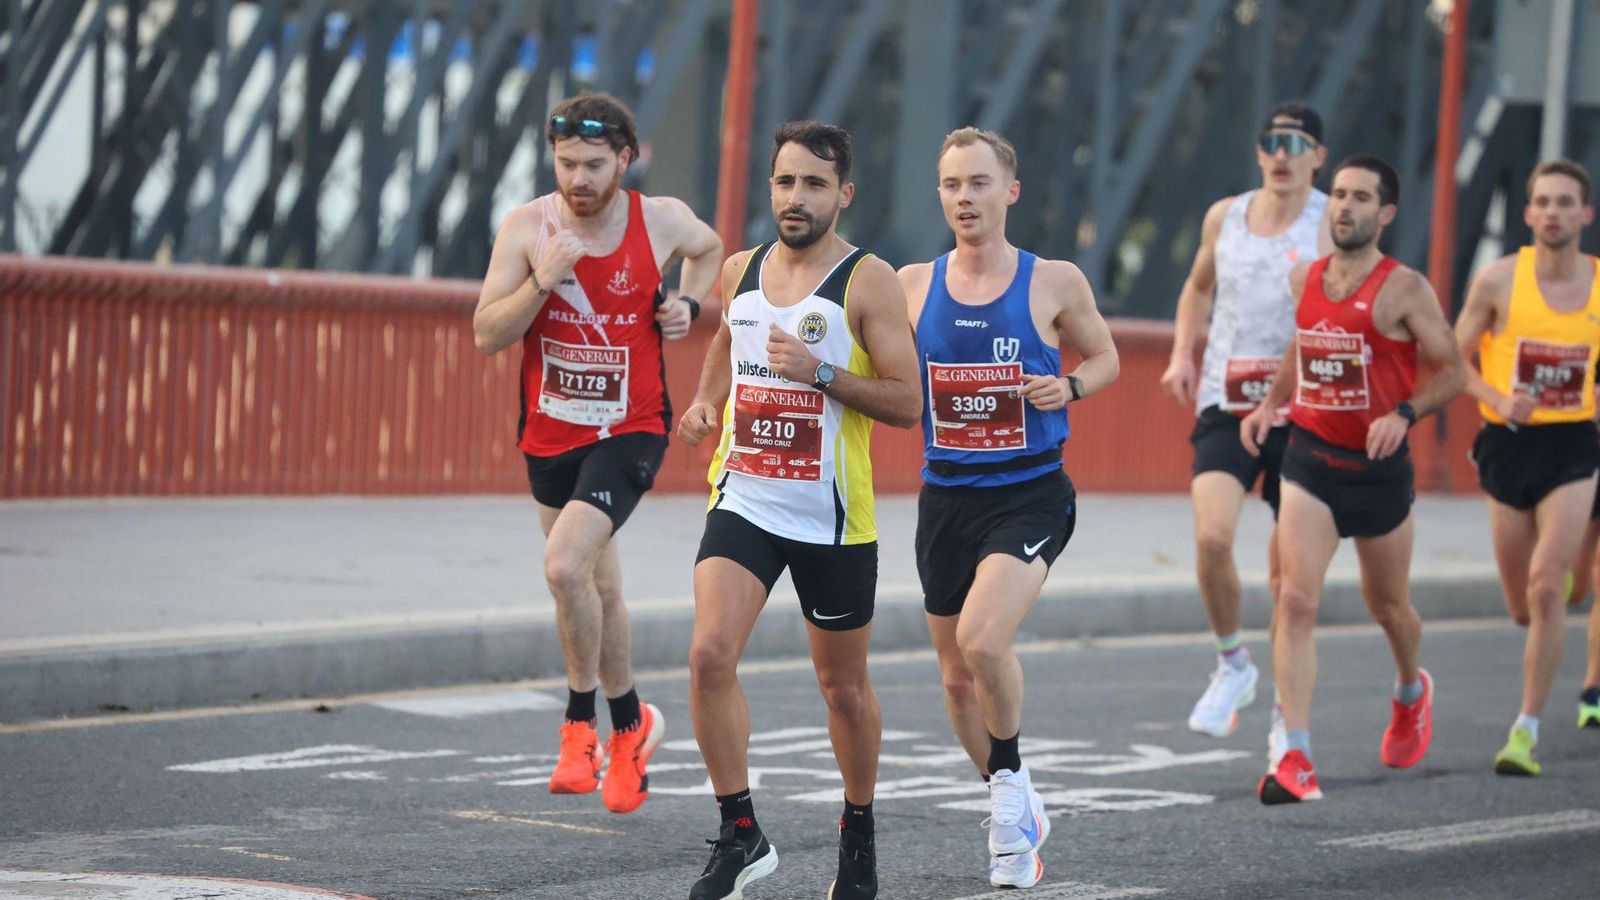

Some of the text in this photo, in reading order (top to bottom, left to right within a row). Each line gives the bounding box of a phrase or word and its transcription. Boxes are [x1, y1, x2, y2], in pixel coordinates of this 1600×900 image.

[548, 309, 611, 325] MALLOW
[738, 319, 760, 328] SPORT
[954, 319, 981, 328] CRAFT
[561, 348, 620, 363] GENERALI
[558, 370, 607, 391] 17178
[950, 367, 1014, 382] GENERALI
[754, 390, 817, 408] GENERALI
[952, 396, 997, 412] 3309
[751, 419, 796, 439] 4210
[753, 437, 792, 448] PEDRO CRUZ
